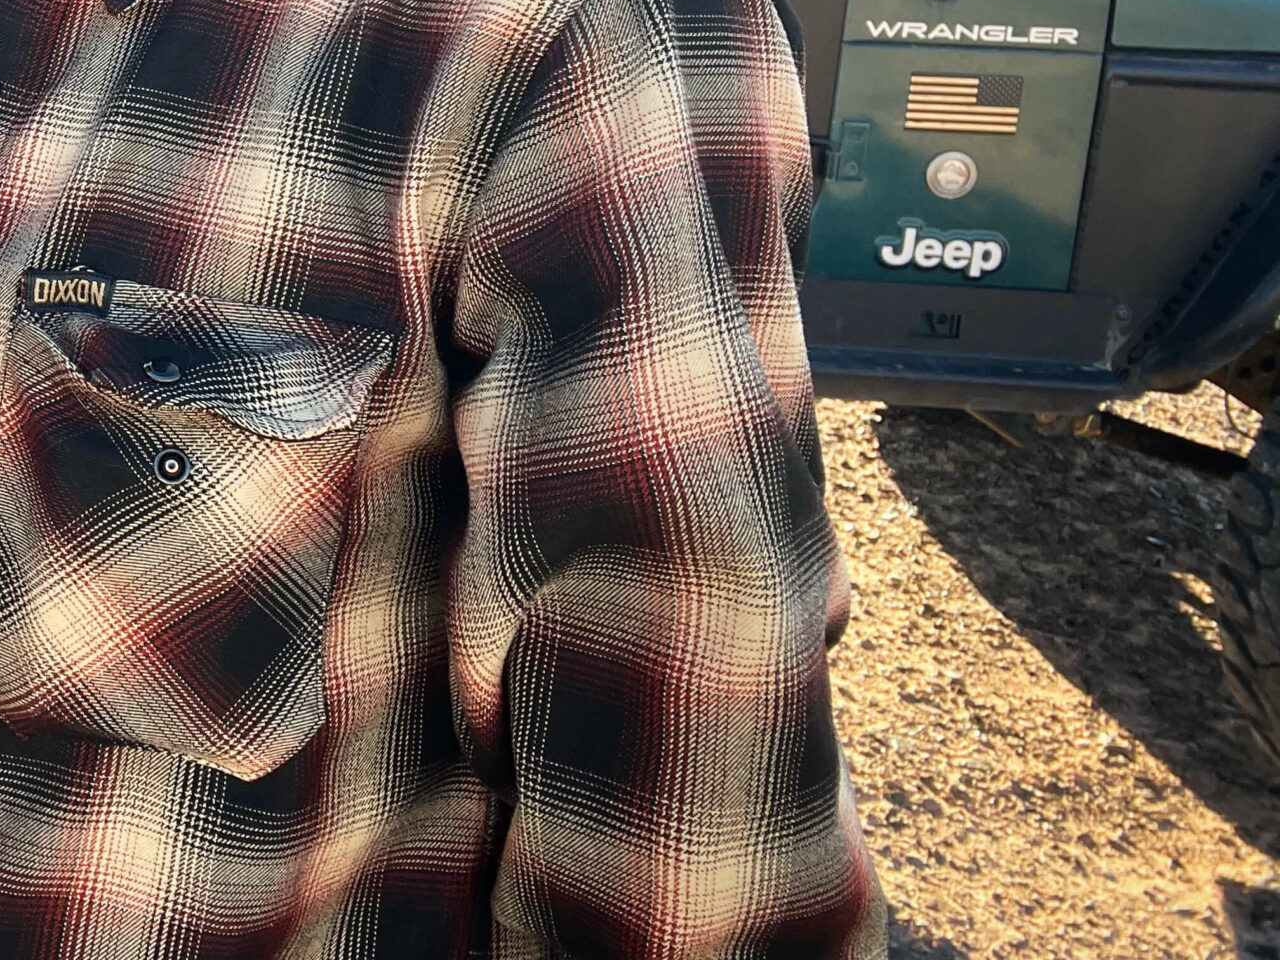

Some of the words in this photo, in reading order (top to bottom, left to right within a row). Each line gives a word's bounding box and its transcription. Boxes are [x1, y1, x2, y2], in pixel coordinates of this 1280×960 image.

[866, 20, 1079, 45] WRANGLER
[880, 226, 1003, 278] Jeep
[33, 278, 106, 308] DIXXON
